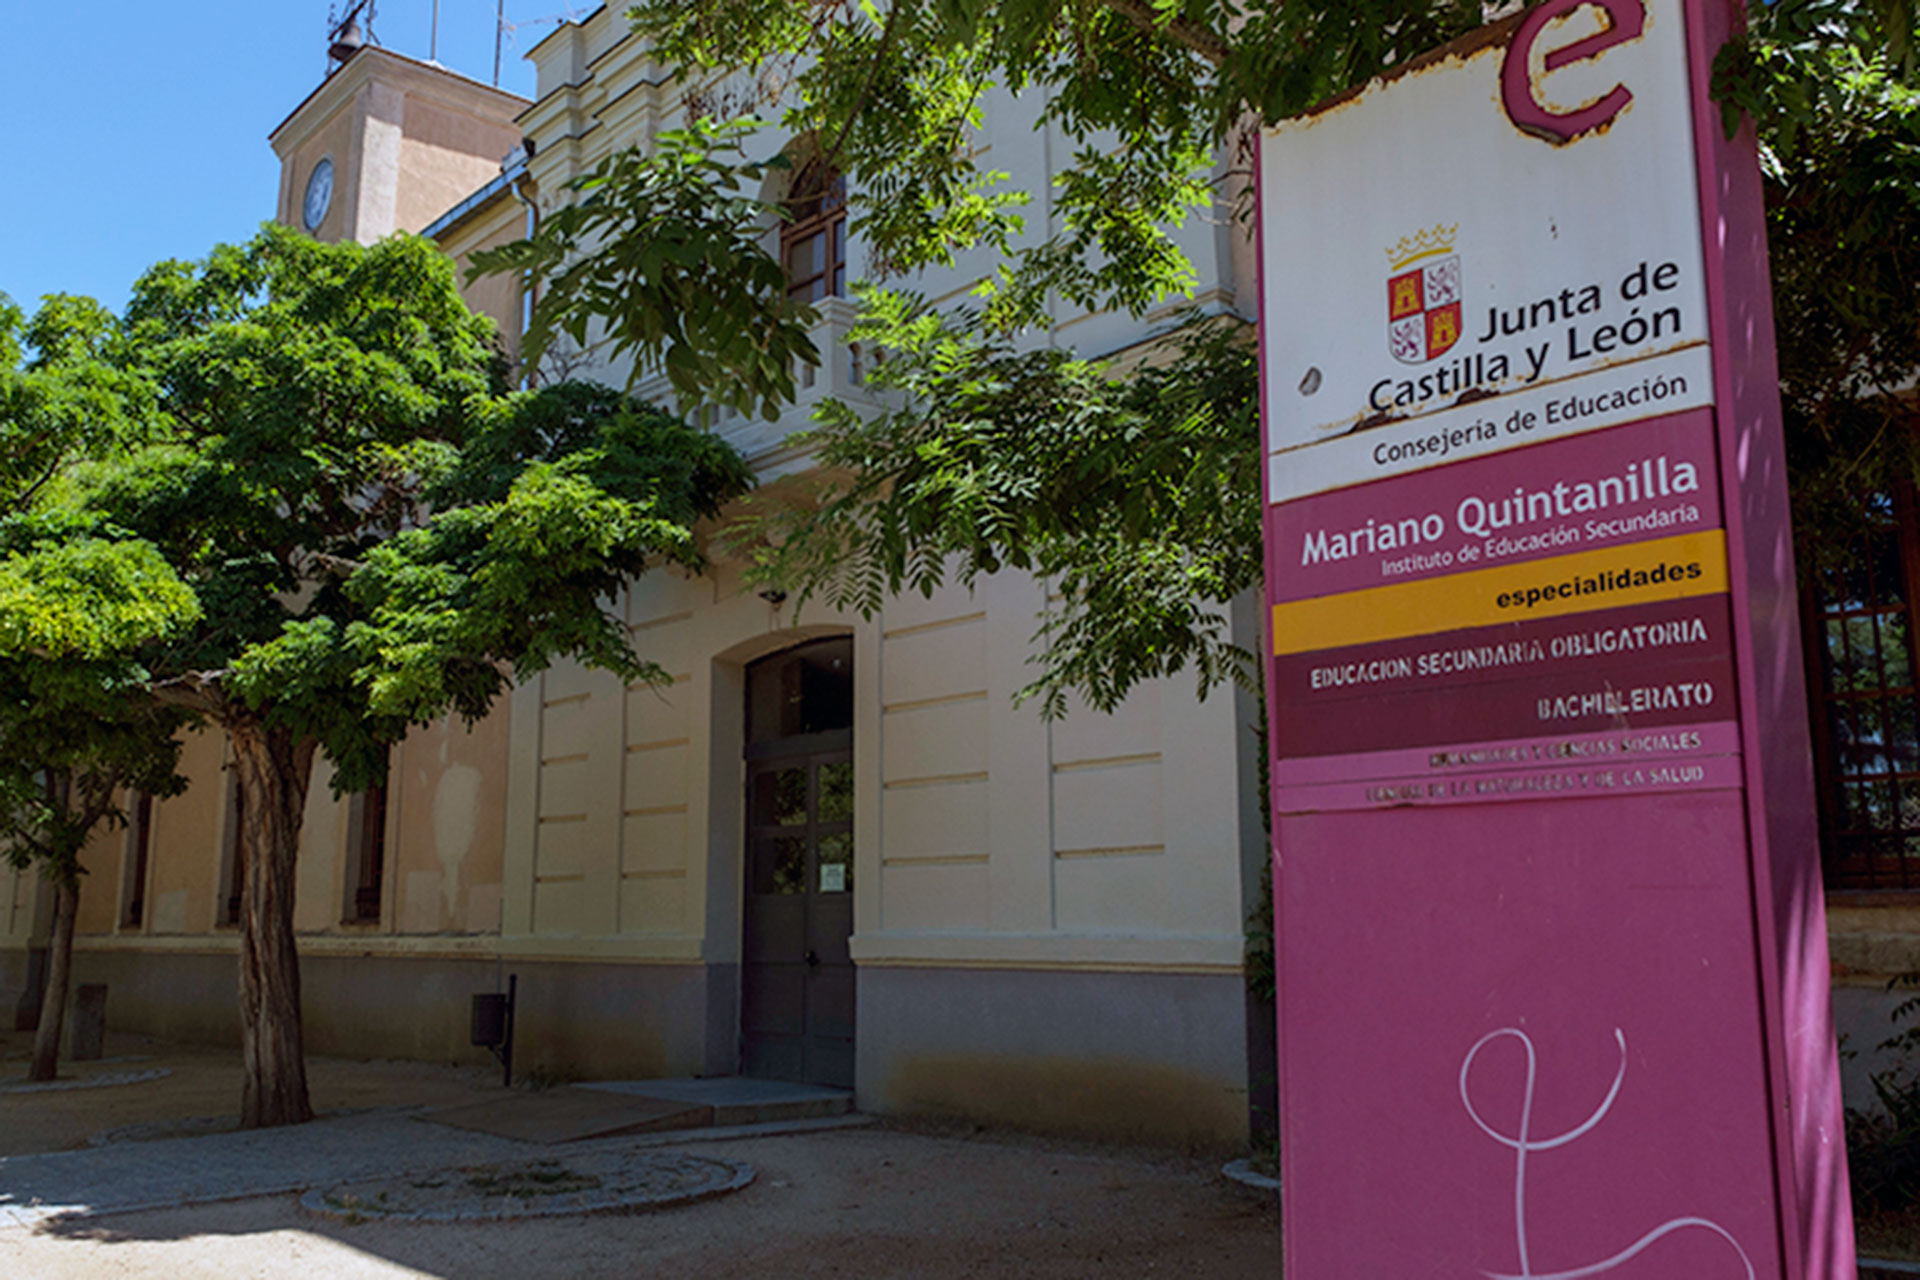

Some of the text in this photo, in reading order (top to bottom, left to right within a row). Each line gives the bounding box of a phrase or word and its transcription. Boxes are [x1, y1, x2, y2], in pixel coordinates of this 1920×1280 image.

[1477, 261, 1679, 343] Junta de
[1368, 306, 1682, 412] Castilla y León
[1372, 375, 1688, 465] Consejería de Educación
[1301, 456, 1699, 567] Mariano Quintanilla
[1382, 503, 1700, 576] Instituto de Educación Secundaria
[1496, 562, 1703, 608] especialidades
[1311, 618, 1708, 690] EDUCACION SECUNDARIA OBLIGATORIA
[1537, 682, 1714, 720] BACHILLERATO
[1620, 732, 1702, 752] SOCIALES
[1623, 769, 1645, 786] LA
[1650, 765, 1705, 785] SALUD
